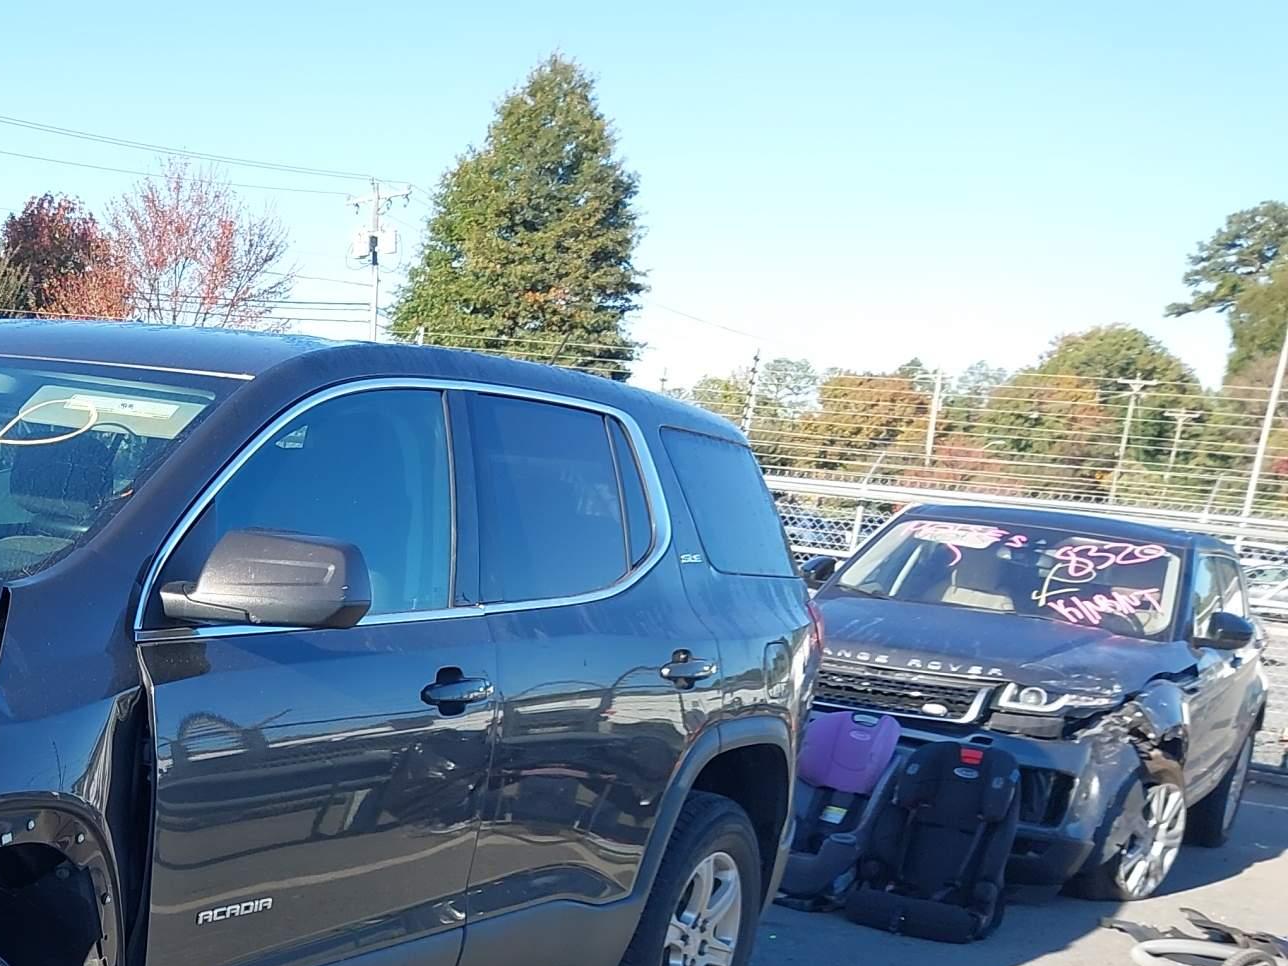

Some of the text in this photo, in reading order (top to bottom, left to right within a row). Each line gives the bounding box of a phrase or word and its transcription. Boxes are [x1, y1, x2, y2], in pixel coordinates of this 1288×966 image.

[823, 647, 1004, 677] ANGE ROVER
[197, 897, 273, 925] ACADIA
